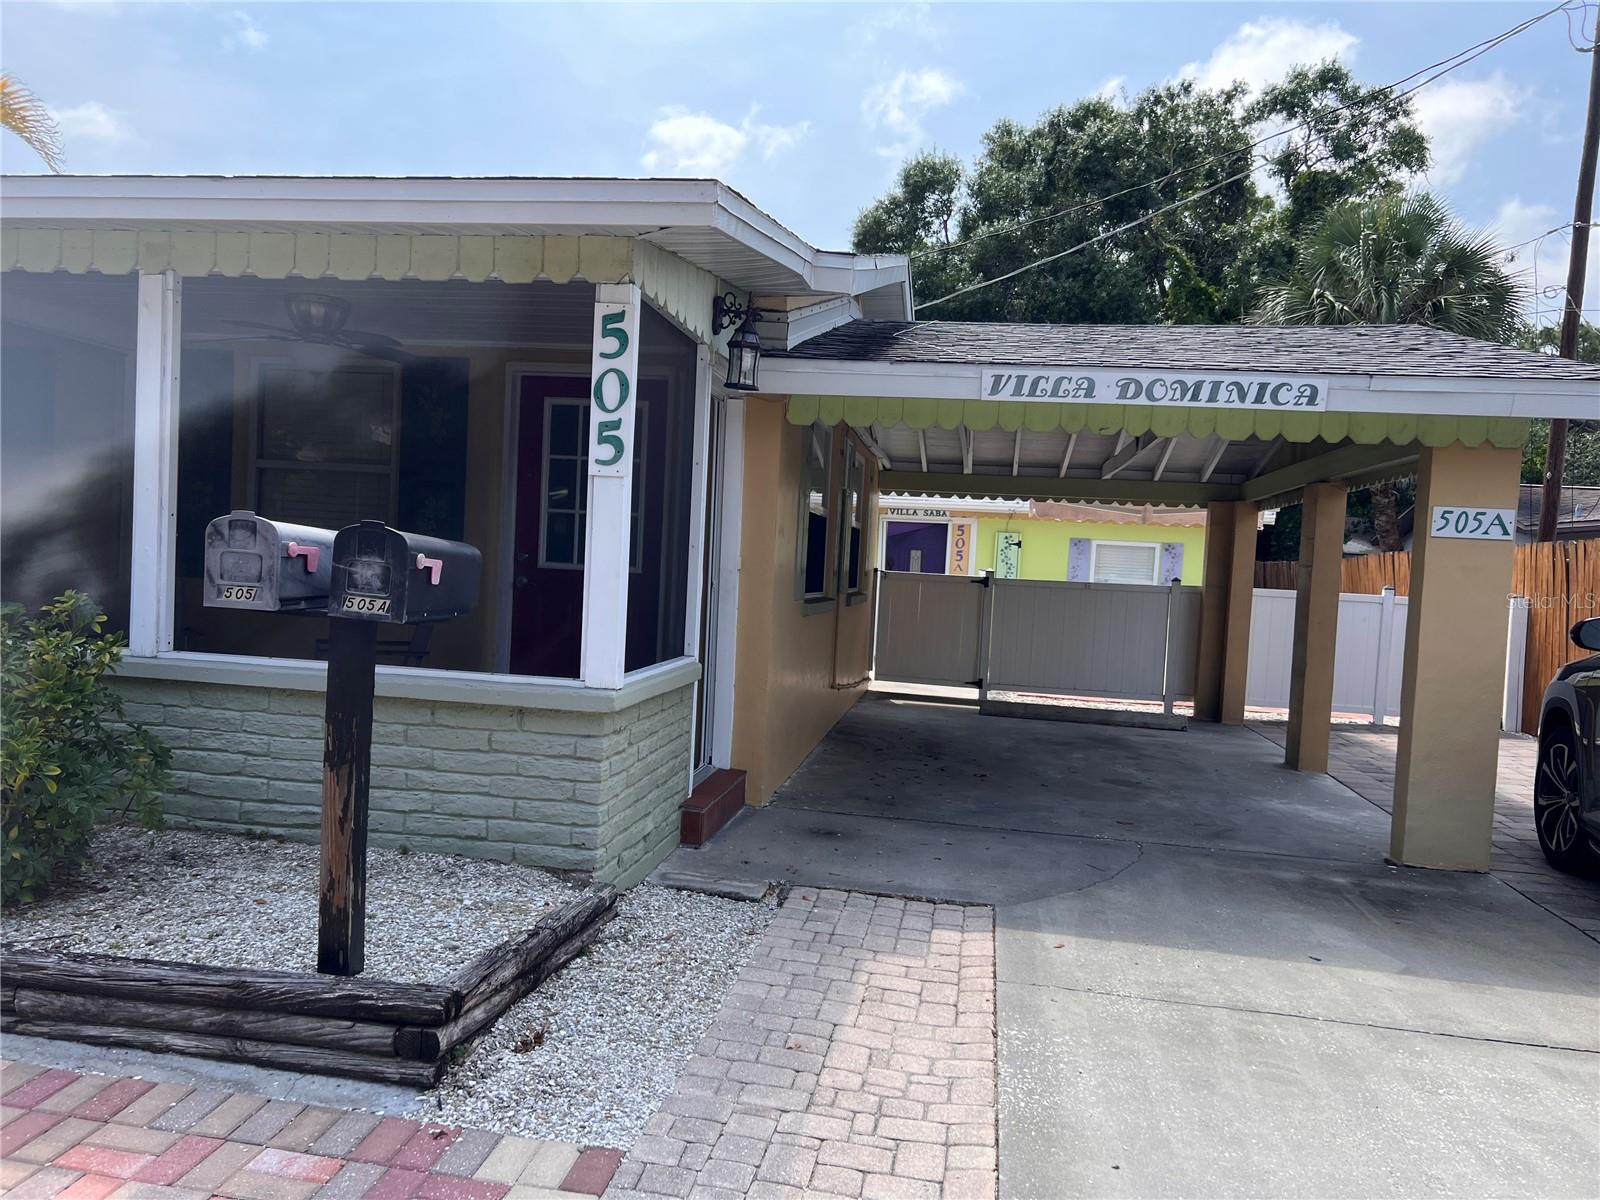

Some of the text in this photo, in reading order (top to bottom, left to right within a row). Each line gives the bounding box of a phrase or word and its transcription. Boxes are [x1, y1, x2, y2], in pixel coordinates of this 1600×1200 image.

[593, 310, 630, 466] 505
[987, 374, 1320, 407] VILLA DOMINICA
[889, 507, 948, 517] VILLA SABA
[1435, 510, 1512, 536] 505A
[953, 524, 965, 572] 505A
[224, 587, 254, 600] 505
[345, 597, 387, 613] 505A
